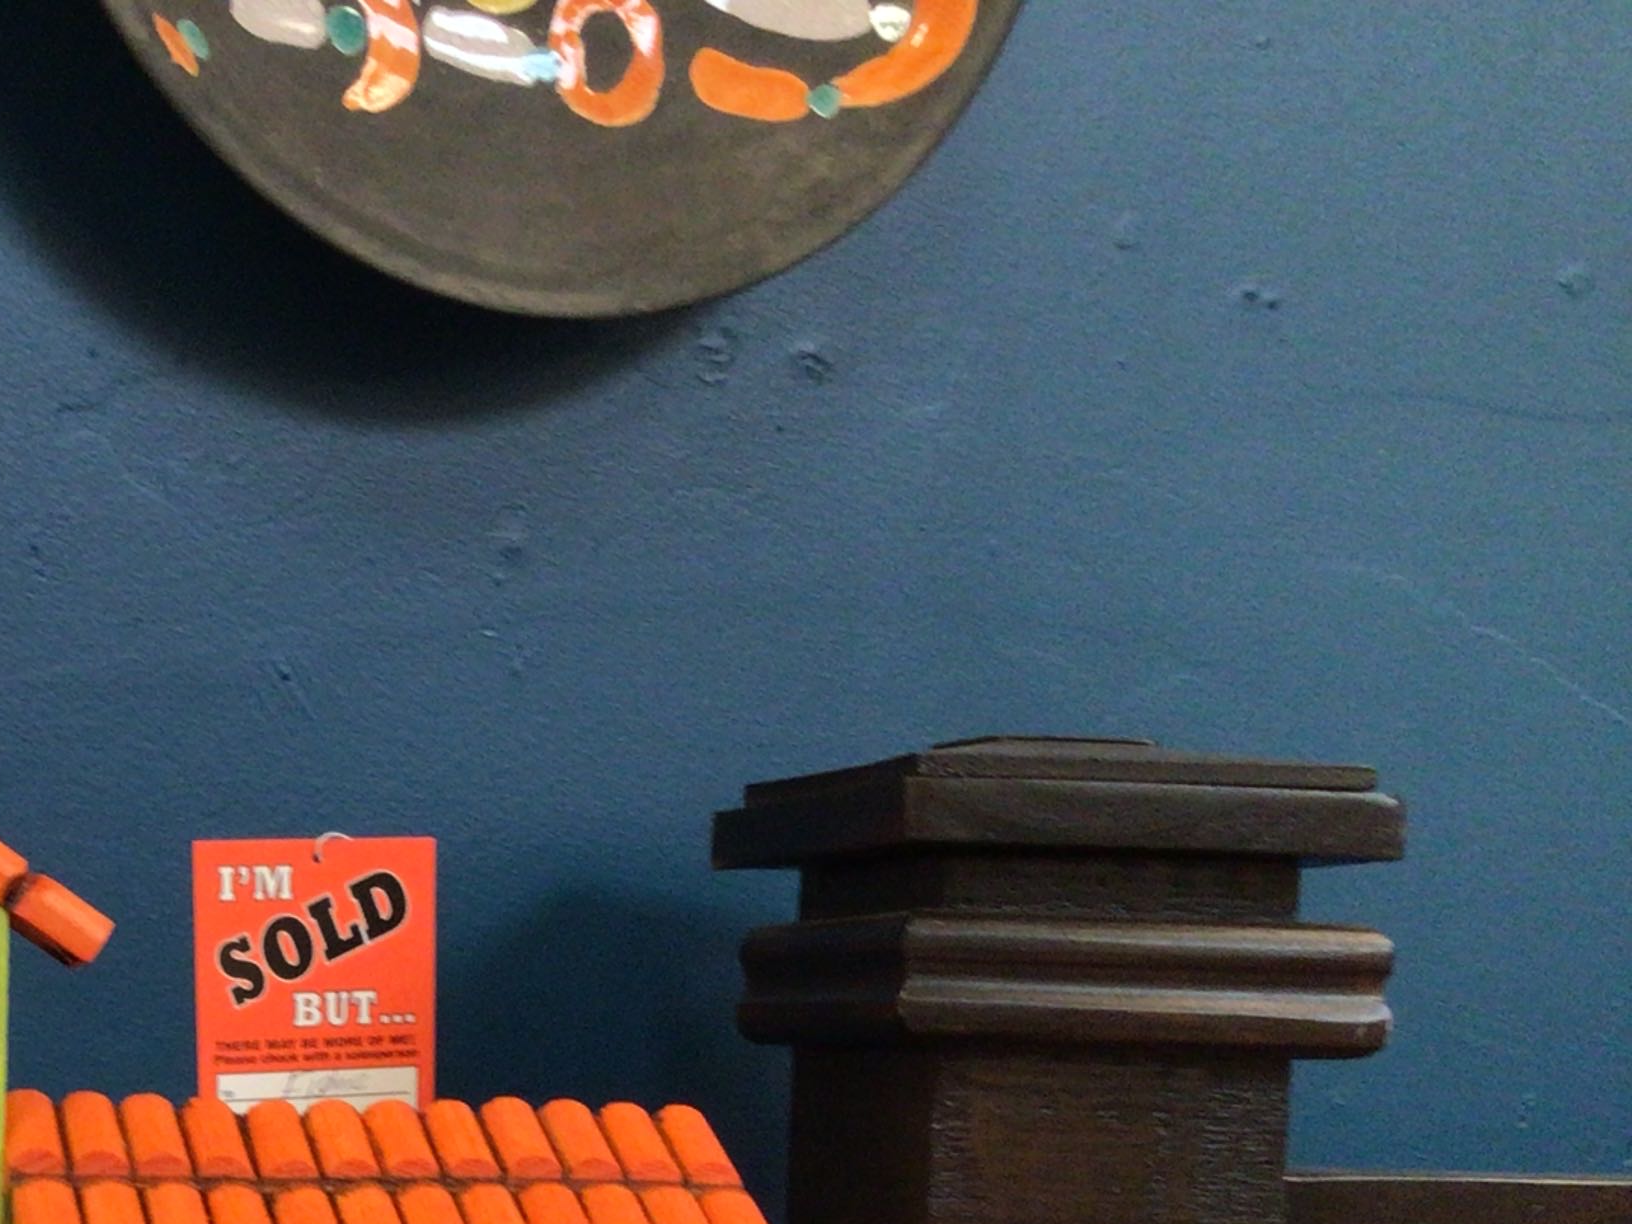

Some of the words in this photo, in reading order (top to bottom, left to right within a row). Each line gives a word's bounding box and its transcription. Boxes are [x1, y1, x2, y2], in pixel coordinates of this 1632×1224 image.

[218, 865, 293, 901] I'M
[218, 871, 407, 1006] SOLD
[292, 991, 416, 1027] BUT...
